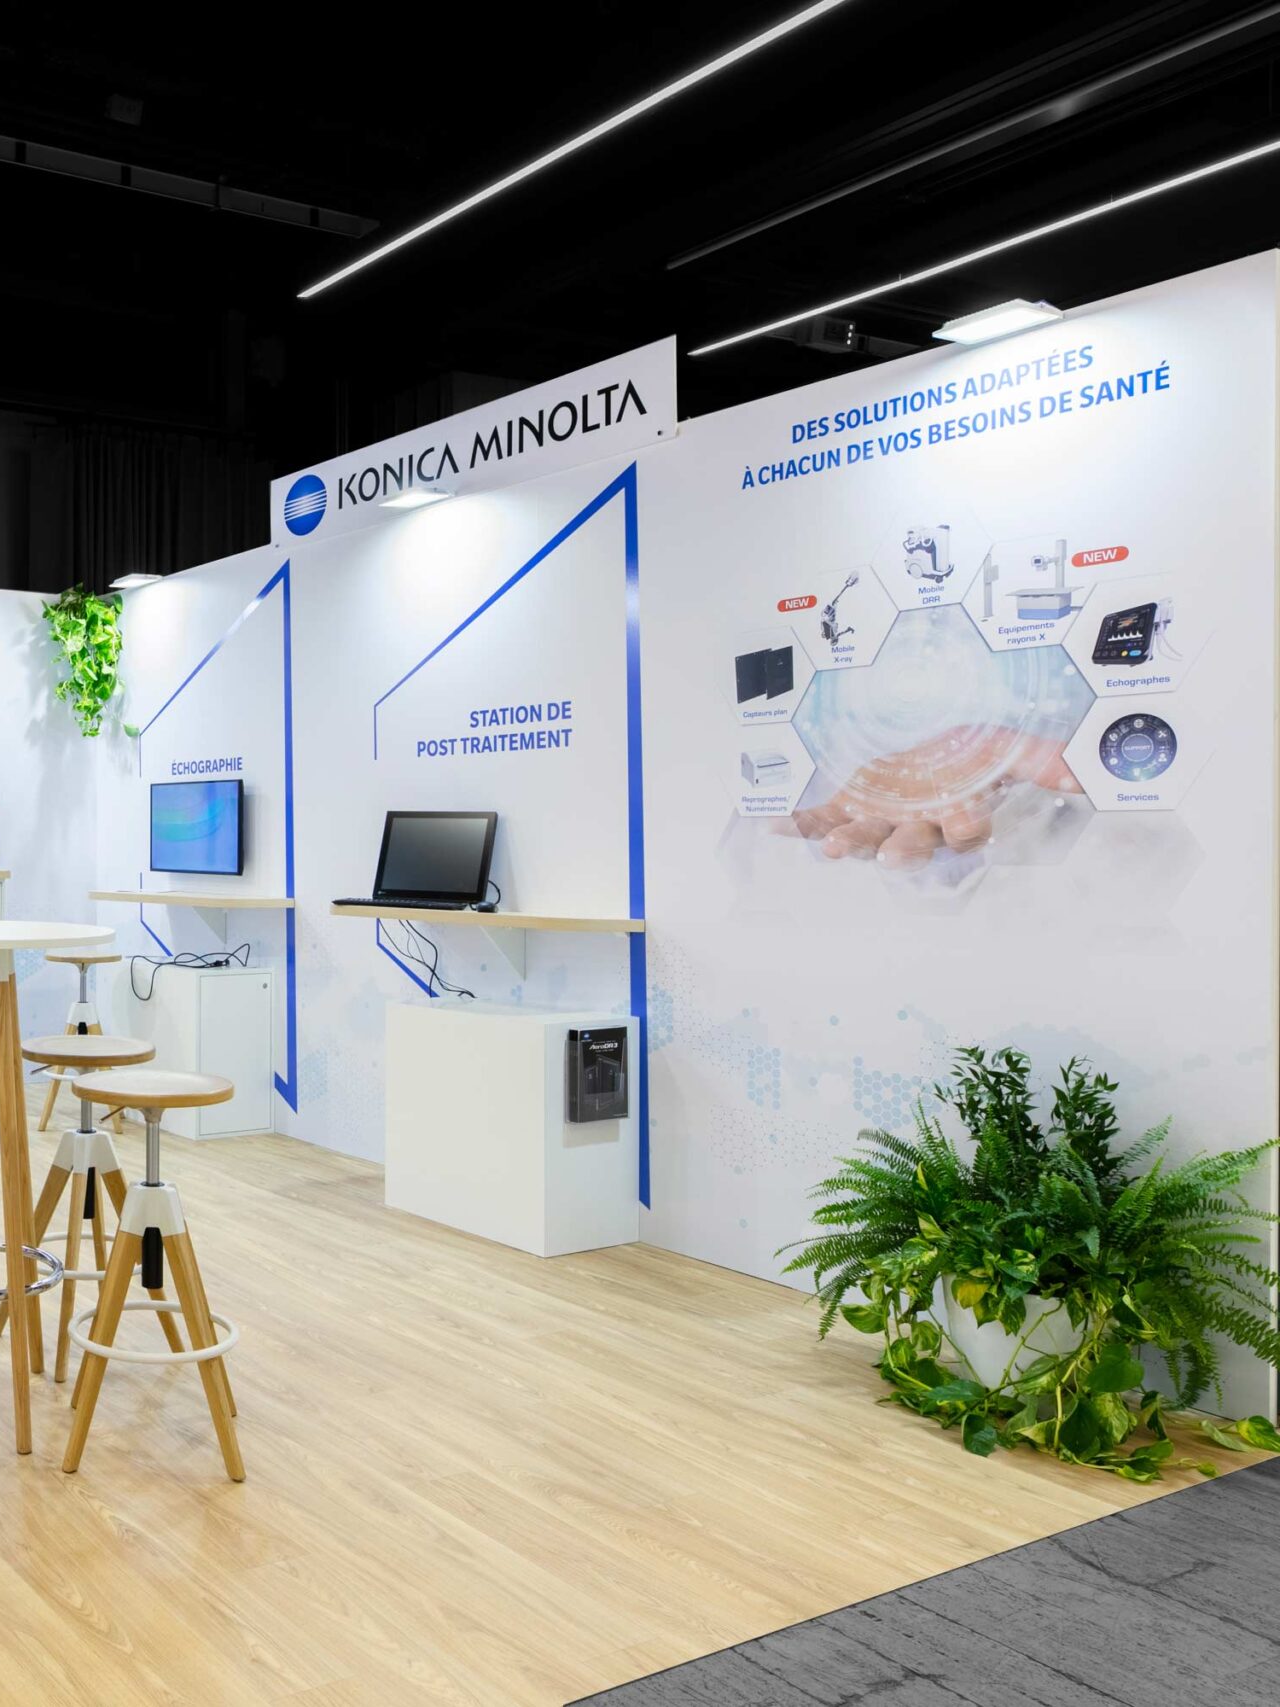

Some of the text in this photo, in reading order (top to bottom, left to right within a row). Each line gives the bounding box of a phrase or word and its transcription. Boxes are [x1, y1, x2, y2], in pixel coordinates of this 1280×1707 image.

[791, 344, 1094, 444] DES SOLUTIONS ADAPTÉES
[741, 360, 1171, 490] À CHACUN DE VOS BESOINS DE SANTÉ
[338, 379, 648, 510] KONICA MINOLTA
[1083, 548, 1118, 564] NEW
[918, 585, 945, 594] Mobile
[785, 597, 810, 609] NEW
[998, 621, 1055, 635] Equipements
[1007, 633, 1046, 645] rayons X
[831, 645, 855, 653] Mobile
[1106, 675, 1171, 688] Echographes
[469, 700, 573, 728] STATION DE
[416, 728, 573, 757] POST TRAITEMENT
[171, 757, 243, 776] ÉCHOGRAPHIE
[1117, 793, 1160, 801] Services
